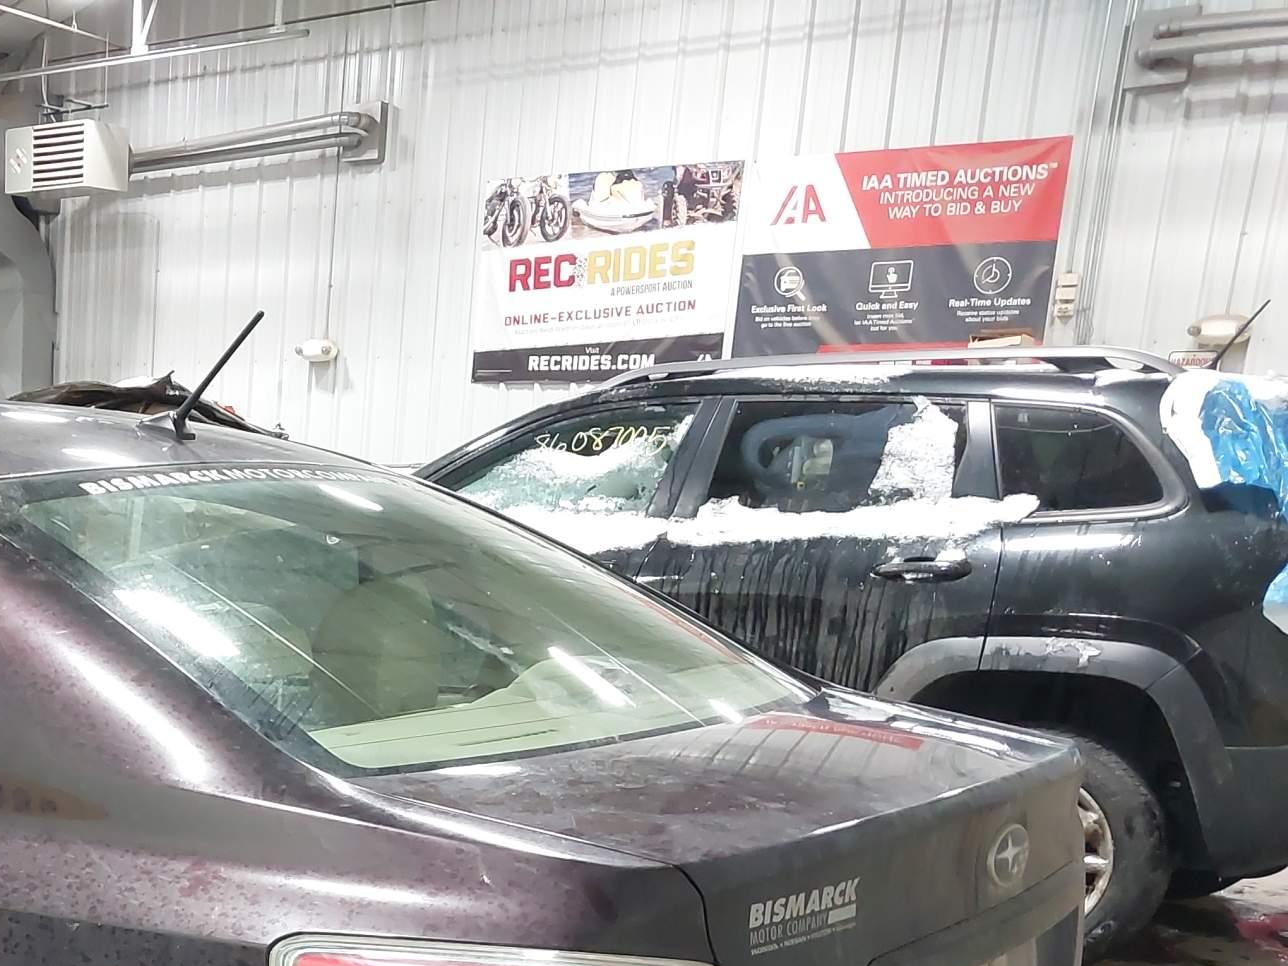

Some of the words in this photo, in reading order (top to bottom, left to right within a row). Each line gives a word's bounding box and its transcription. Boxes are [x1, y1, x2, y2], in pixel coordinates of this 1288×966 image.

[862, 174, 893, 190] IAA
[897, 170, 949, 188] TIMED
[879, 187, 979, 204] INTRODUCING
[982, 185, 995, 198] A
[998, 183, 1035, 197] NEW
[888, 205, 920, 219] WAY
[923, 203, 942, 216] TO
[946, 201, 971, 216] BID
[974, 201, 987, 214] &
[990, 199, 1023, 213] BUY
[508, 253, 578, 292] REC
[586, 239, 696, 285] RIDES
[662, 279, 693, 292] AUCTION
[751, 304, 786, 314] Exclusive
[806, 303, 828, 312] Look
[855, 301, 880, 311] Quick
[898, 300, 919, 311] Easy
[993, 296, 1032, 308] Updates
[504, 305, 632, 326] ONLINE-EXCLUSIVE
[636, 299, 697, 315] AUCTION
[528, 353, 655, 371] RECRIDES.COM
[749, 876, 861, 929] BISMARCK
[750, 924, 784, 946] MOTOR
[786, 912, 828, 937] COMPANY
